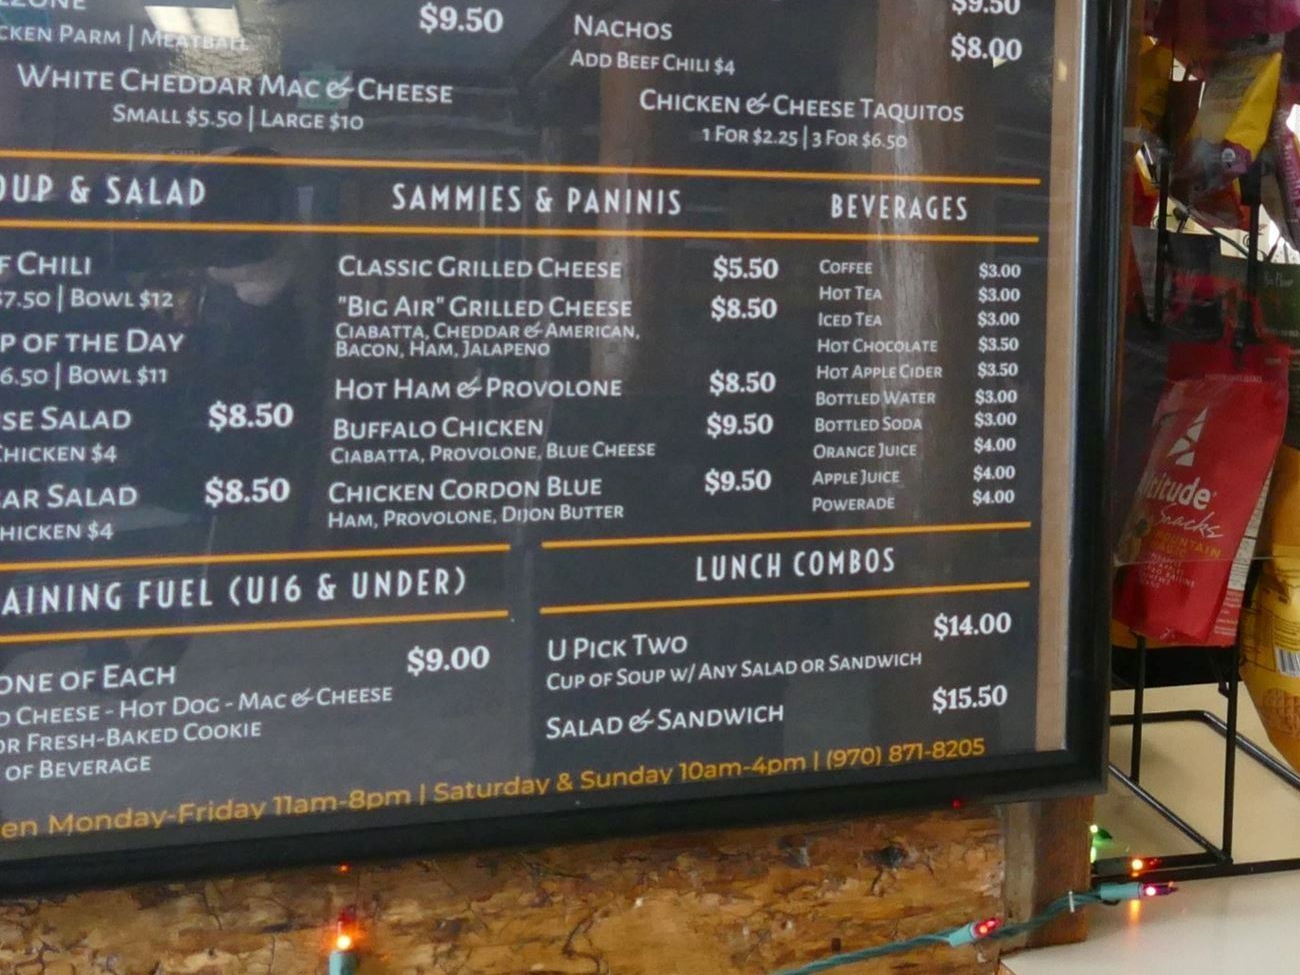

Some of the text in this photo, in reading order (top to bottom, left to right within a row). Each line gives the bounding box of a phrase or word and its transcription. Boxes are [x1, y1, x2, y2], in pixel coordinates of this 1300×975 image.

[952, 33, 1022, 66] $8.00
[393, 183, 680, 215] SAMMIES & PANINIS
[831, 194, 967, 220] BEVERAGES
[714, 255, 778, 281] $5.50
[979, 262, 1021, 279] $3.00
[209, 401, 293, 432] $8.50
[973, 489, 1015, 506] $4.00
[697, 548, 894, 581] LUNCH COMBOS
[139, 567, 465, 608] FUEL (U16 & UNDER)
[934, 612, 1011, 640] $14.00
[48, 737, 985, 835] Monday-Friday 11am-8pm Saturday & Sunday 10am-4pm (970) 871-8205
